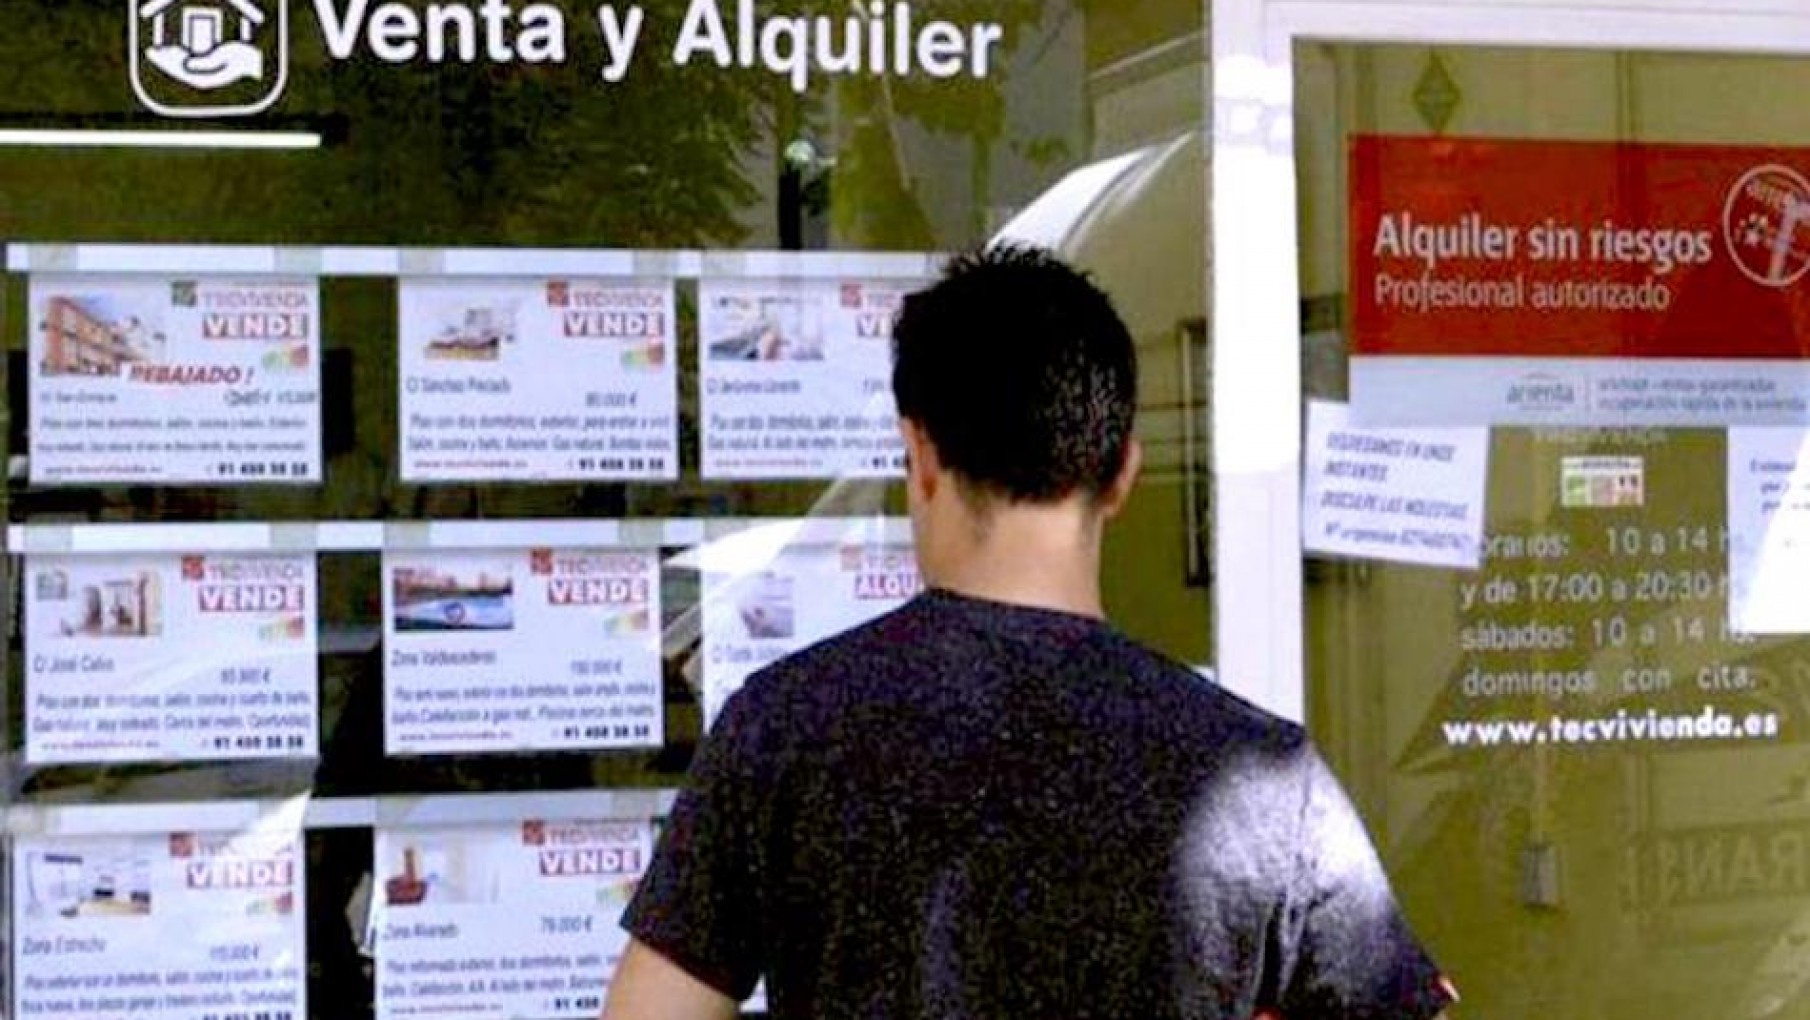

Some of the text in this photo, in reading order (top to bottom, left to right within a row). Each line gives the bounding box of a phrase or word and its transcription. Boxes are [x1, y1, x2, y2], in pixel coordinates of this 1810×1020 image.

[313, 0, 1003, 91] Venta y Alquiler
[1374, 212, 1713, 274] Alquiler sin riesgos
[1375, 272, 1671, 313] Profesional autorizado
[203, 313, 308, 339] VENDE
[563, 312, 664, 337] VENDE
[1478, 533, 1570, 558] orarios:
[1608, 527, 1639, 554] 10
[1651, 533, 1666, 554] a
[1676, 526, 1708, 552] 14
[200, 585, 303, 611] VENDE
[548, 579, 648, 605] VENDE
[1460, 571, 1711, 610] y de 17:00 a 20:30
[1594, 616, 1626, 645] 10
[1640, 623, 1656, 644] a
[1674, 616, 1704, 642] 14
[1462, 668, 1596, 700] domingos
[1621, 668, 1672, 692] con
[1443, 704, 1778, 746] www.tecvivienda.es
[187, 860, 293, 888] VENDE
[539, 850, 640, 876] VENDE
